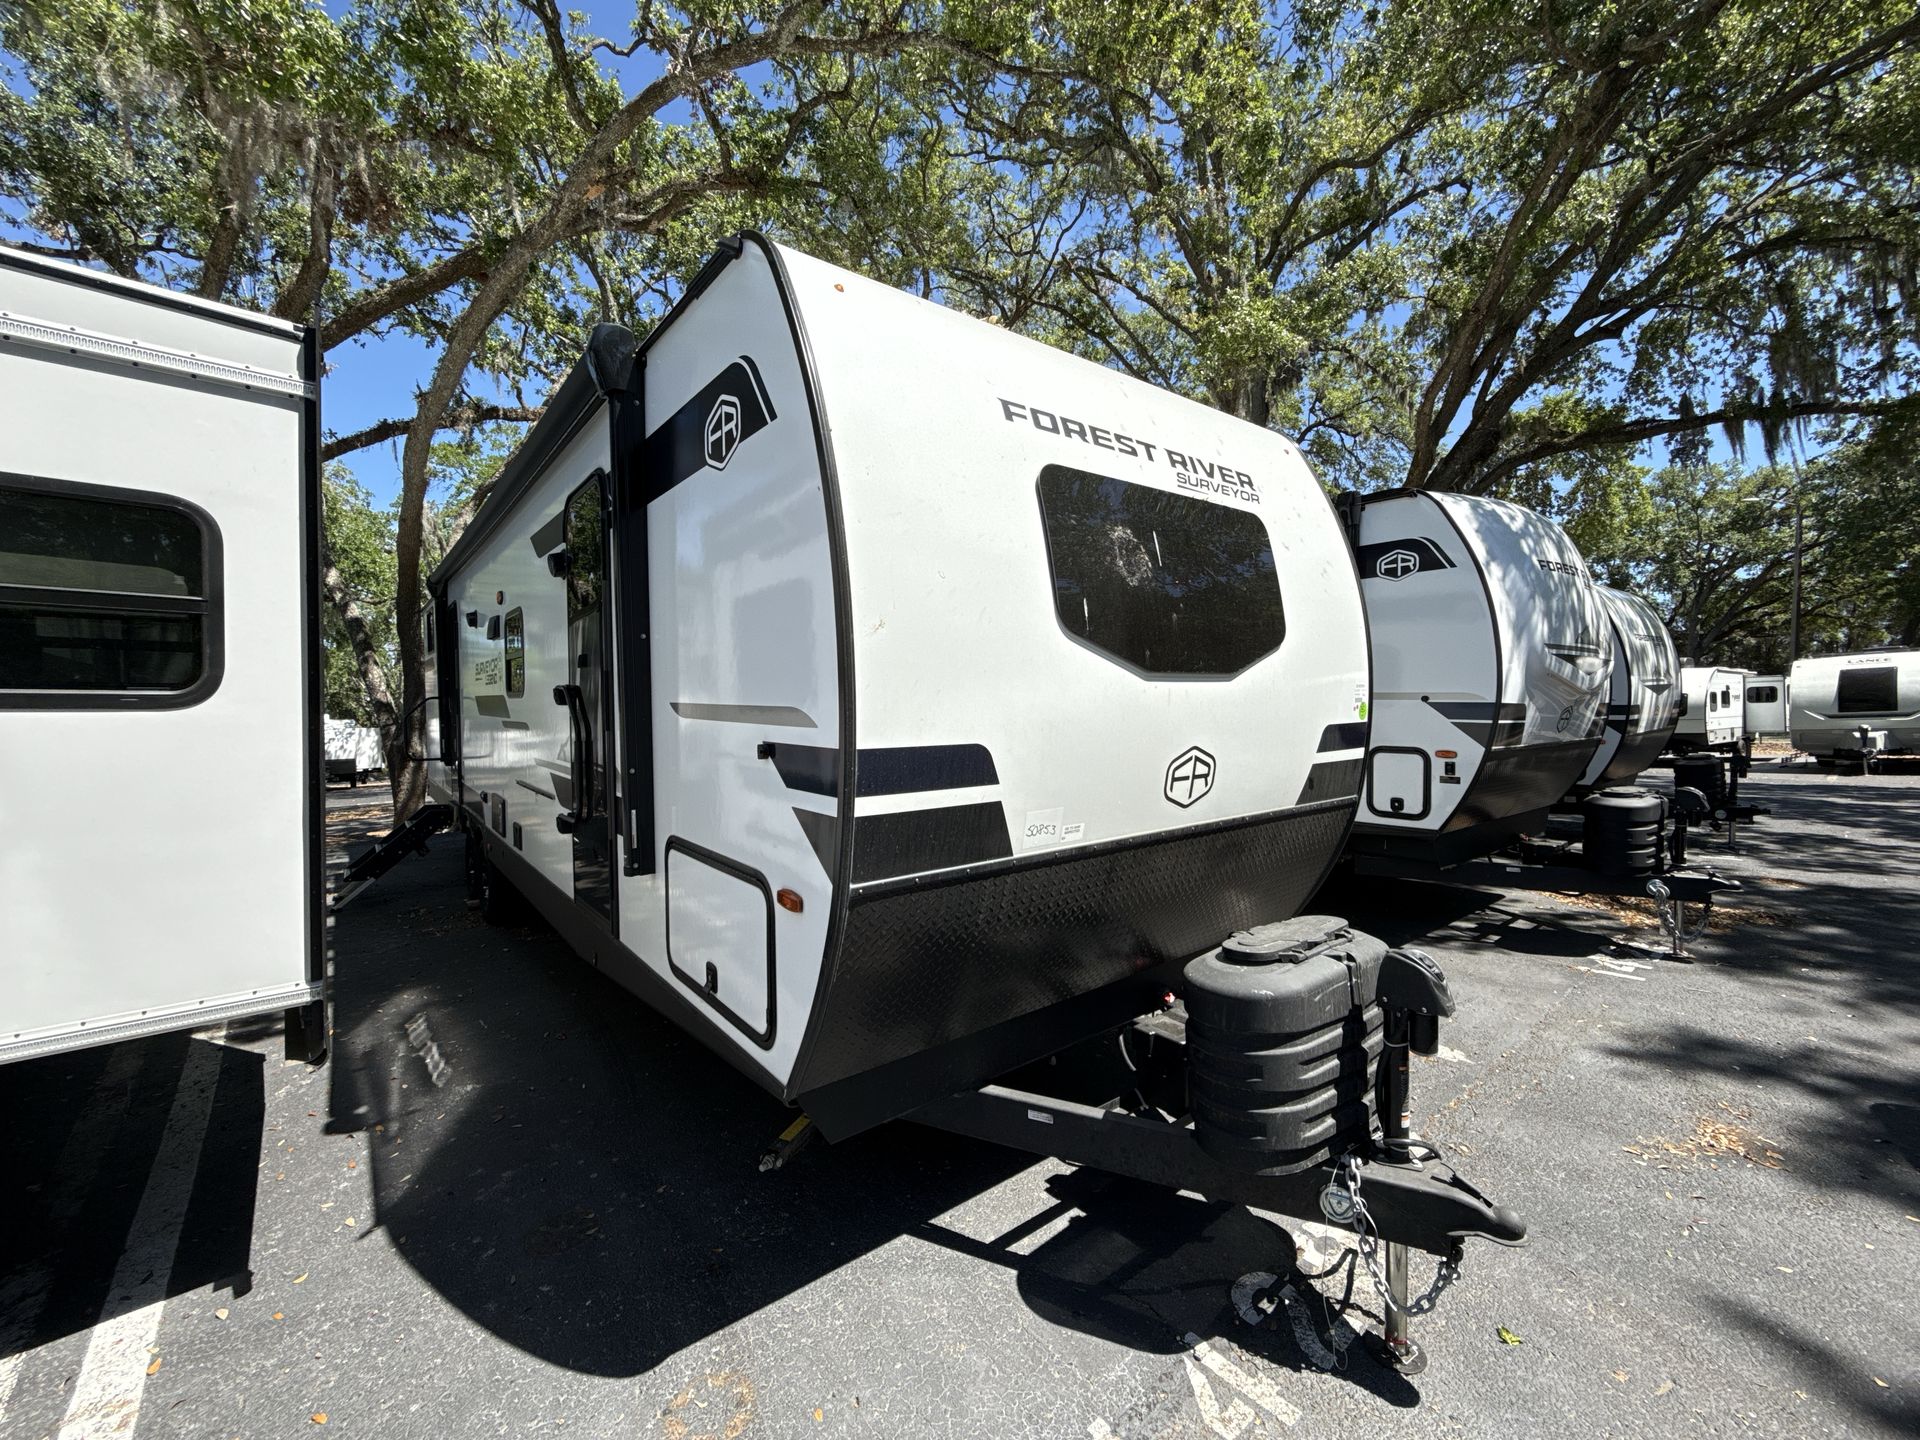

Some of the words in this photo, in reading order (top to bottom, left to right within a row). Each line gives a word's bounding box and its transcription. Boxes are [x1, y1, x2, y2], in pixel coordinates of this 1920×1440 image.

[997, 397, 1157, 462] FOREST
[1163, 448, 1257, 491] RIVER
[1176, 472, 1261, 504] SURVEYOR
[1537, 559, 1580, 577] FOREST
[1025, 823, 1057, 838] 50853
